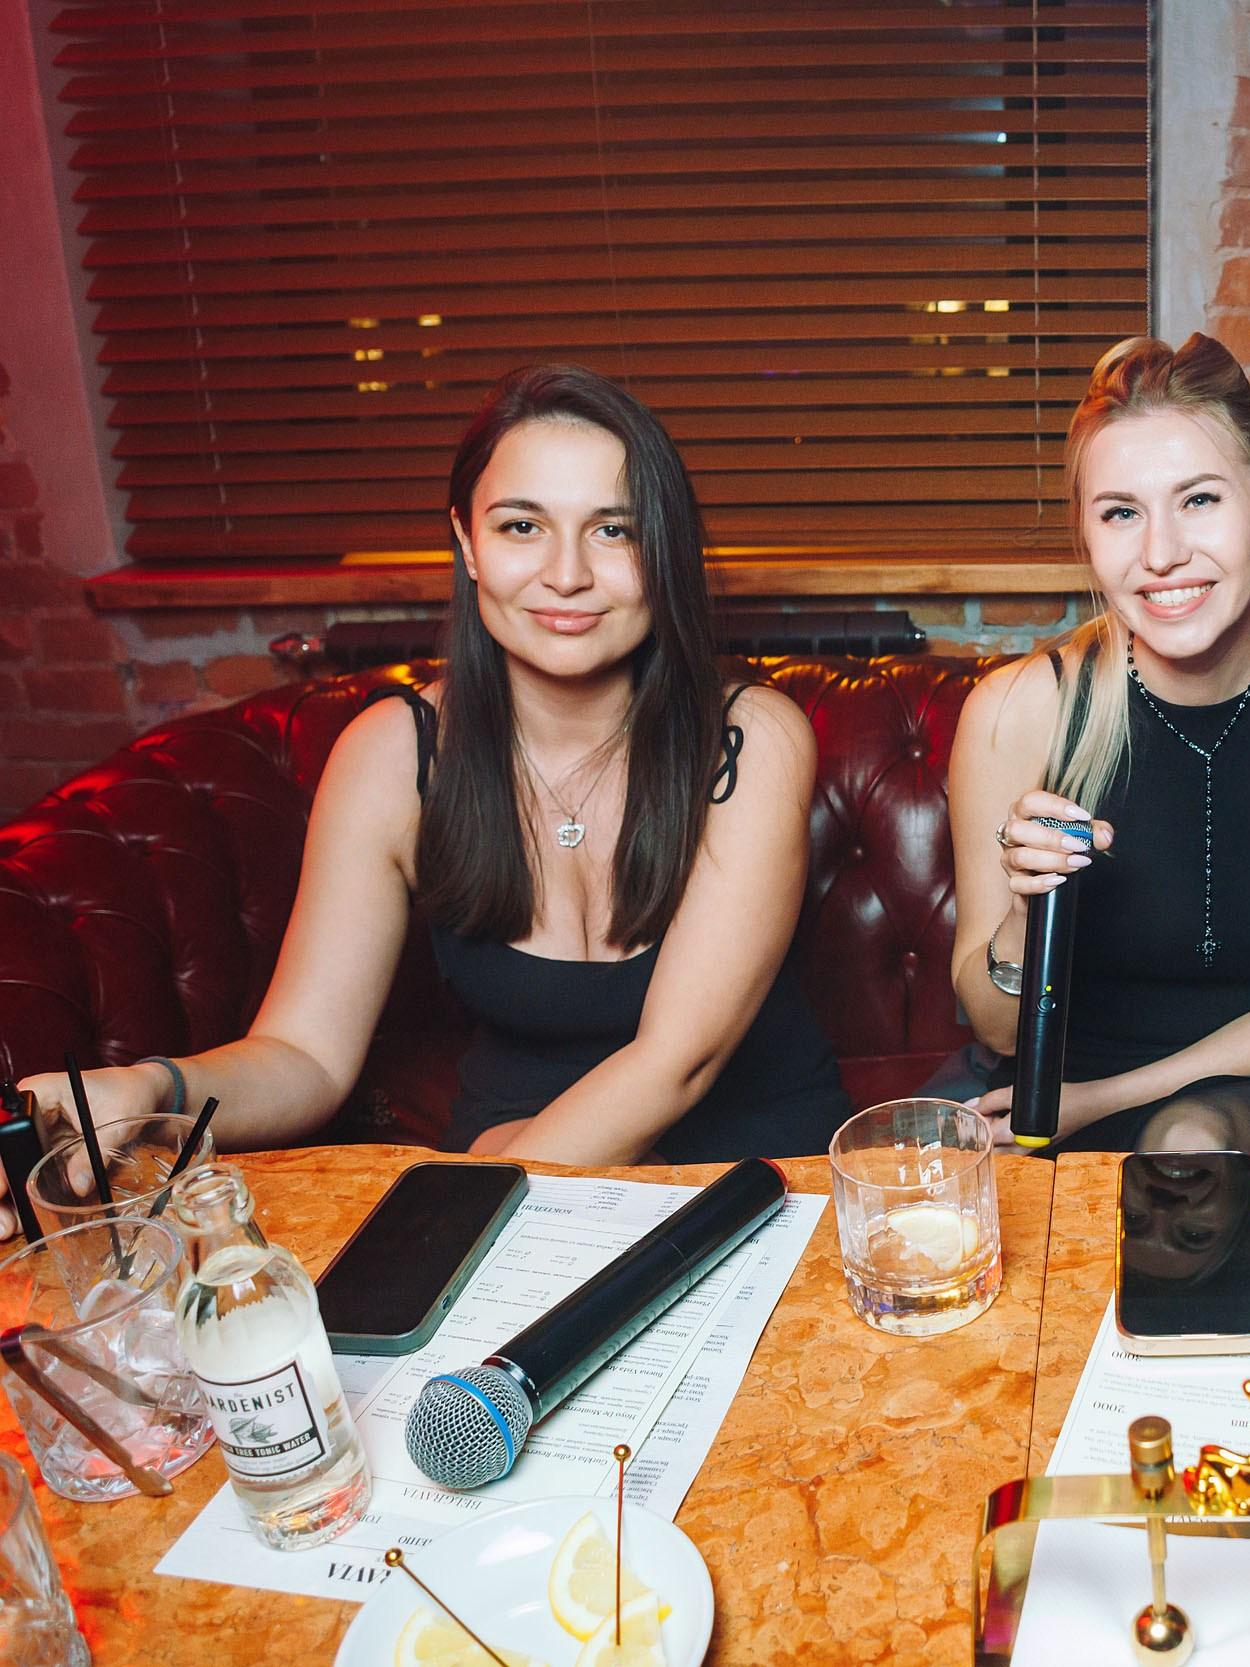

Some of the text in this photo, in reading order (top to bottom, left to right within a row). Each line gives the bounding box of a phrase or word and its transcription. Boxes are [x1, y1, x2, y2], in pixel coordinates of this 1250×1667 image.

[617, 1366, 638, 1374] Vista
[638, 1369, 663, 1377] Buena
[203, 1383, 294, 1413] ARDENIST
[1091, 1400, 1126, 1412] 2000
[235, 1447, 254, 1457] FREE
[256, 1445, 281, 1457] TONIC
[283, 1432, 312, 1451] WATER
[551, 1451, 576, 1460] Cellar
[575, 1455, 607, 1466] Gurkha
[402, 1487, 482, 1511] BELGRAVIA
[398, 1534, 434, 1547] ЕНЮ
